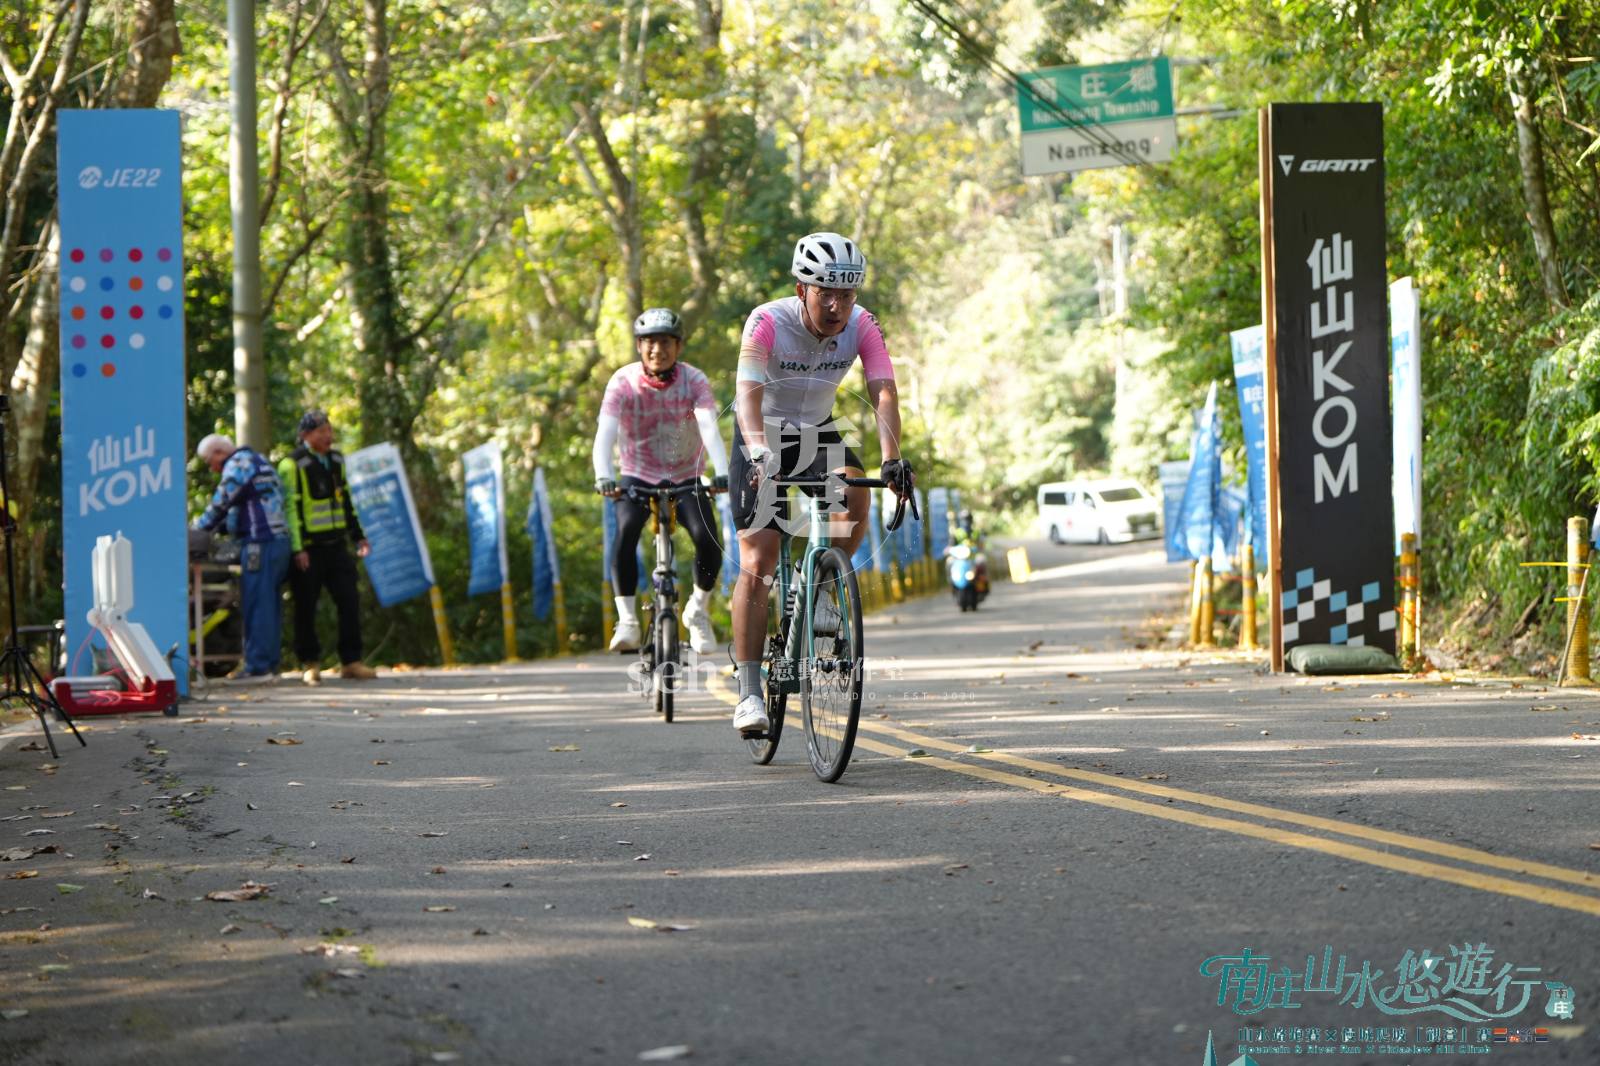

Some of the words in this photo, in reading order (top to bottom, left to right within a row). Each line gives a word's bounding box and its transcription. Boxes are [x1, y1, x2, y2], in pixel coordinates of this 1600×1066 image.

[1103, 98, 1159, 117] Township
[1299, 158, 1377, 173] GIANT
[103, 168, 162, 188] JE22
[779, 361, 810, 373] VAN
[814, 359, 853, 373] RYSE
[88, 424, 155, 476] 仙山
[80, 457, 171, 517] KOM
